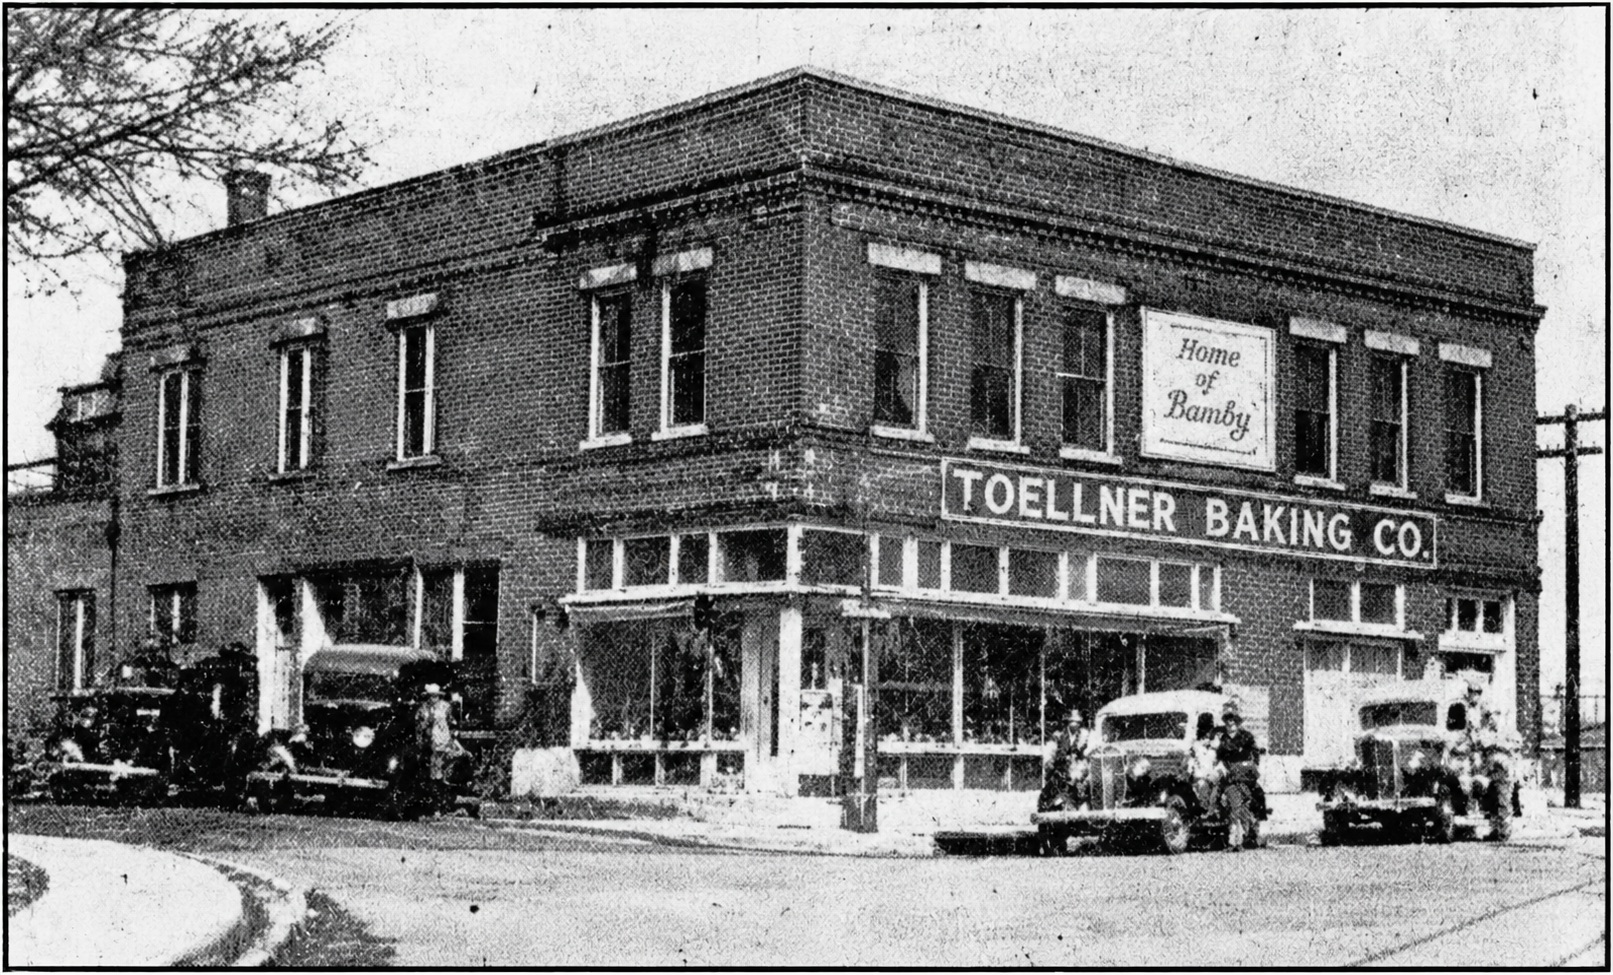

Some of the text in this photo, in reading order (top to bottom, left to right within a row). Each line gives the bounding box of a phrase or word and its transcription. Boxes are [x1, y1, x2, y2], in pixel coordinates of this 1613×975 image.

[1175, 338, 1241, 367] Home
[1195, 369, 1220, 395] of
[1163, 389, 1251, 442] Bamby
[953, 468, 1429, 558] TOELLNER BAKING CO.
